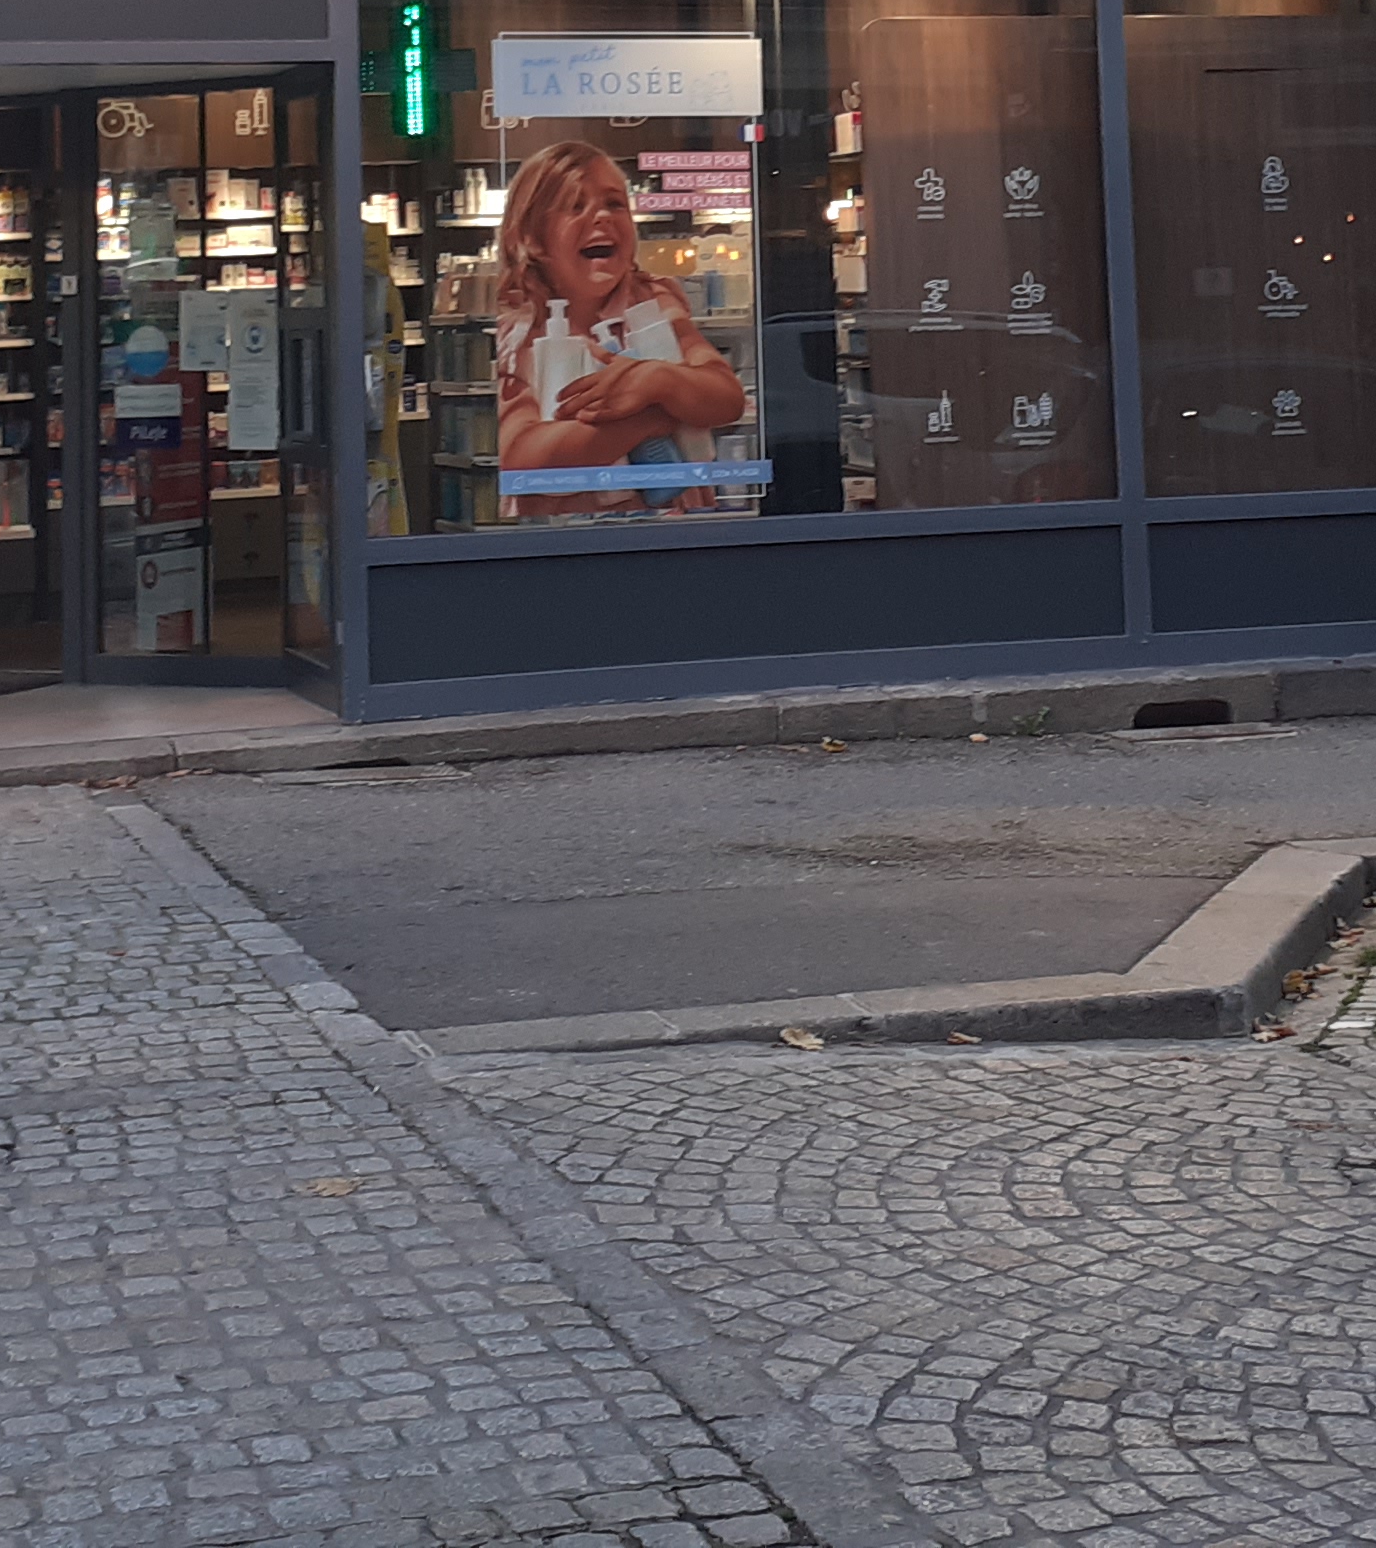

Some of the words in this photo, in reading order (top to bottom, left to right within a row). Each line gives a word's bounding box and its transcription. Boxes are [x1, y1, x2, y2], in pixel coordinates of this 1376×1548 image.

[522, 73, 563, 95] LA
[578, 66, 685, 95] ROSÉE
[642, 154, 657, 168] LE
[657, 154, 713, 168] MEILLEUR
[714, 153, 750, 168] POUR
[666, 175, 695, 188] NOS
[733, 173, 750, 187] ET
[638, 196, 673, 209] POUR
[674, 196, 691, 208] LA
